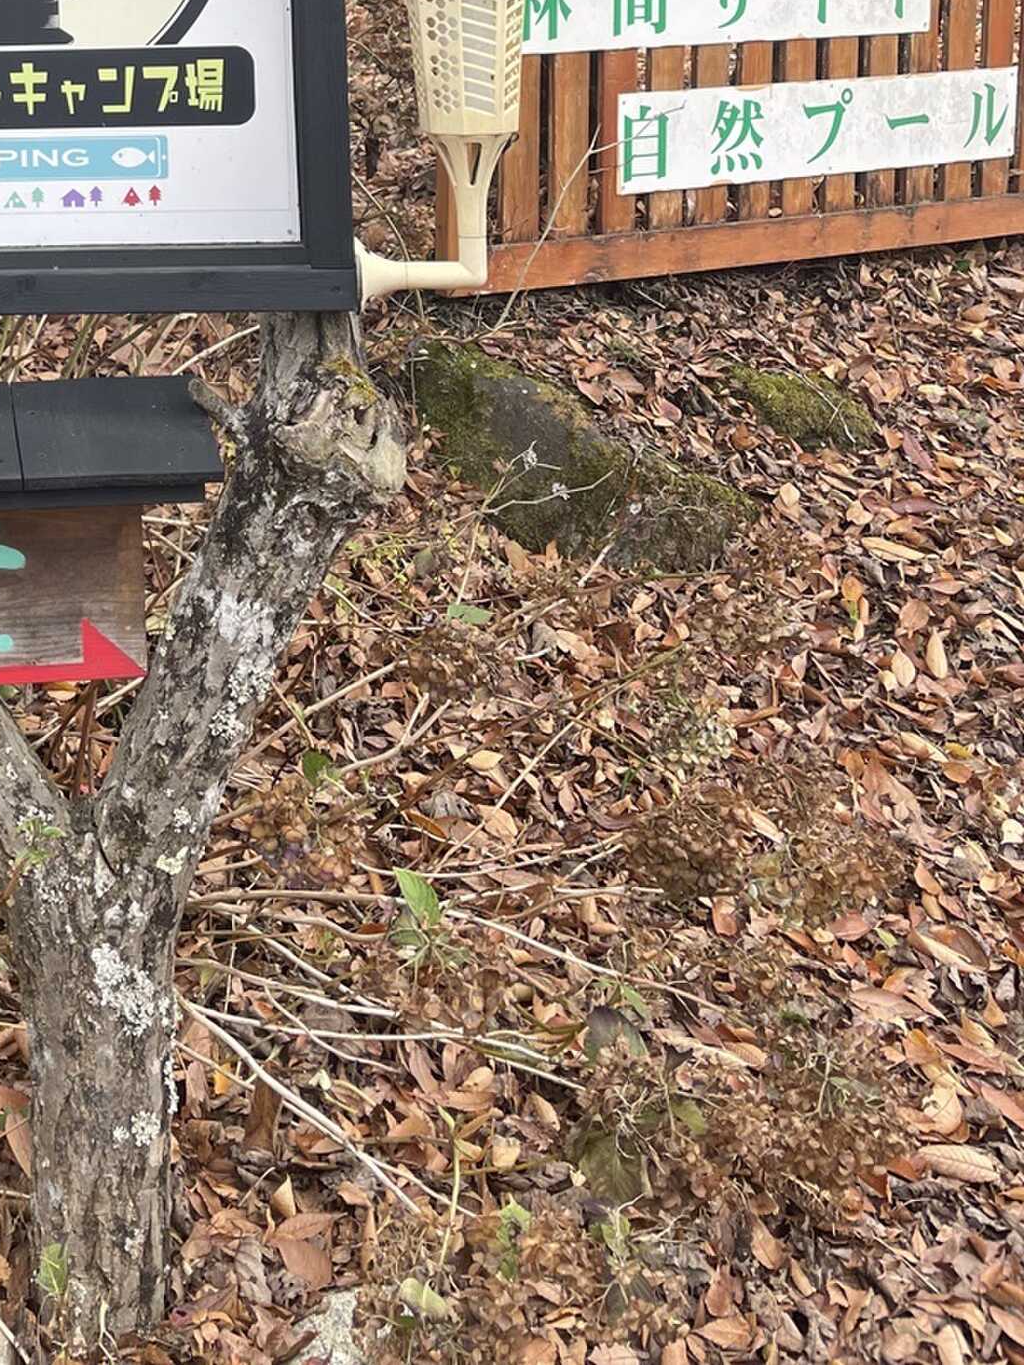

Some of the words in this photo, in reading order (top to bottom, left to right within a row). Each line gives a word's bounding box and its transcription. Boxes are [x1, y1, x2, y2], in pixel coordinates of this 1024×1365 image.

[622, 83, 1009, 183] 自然プール
